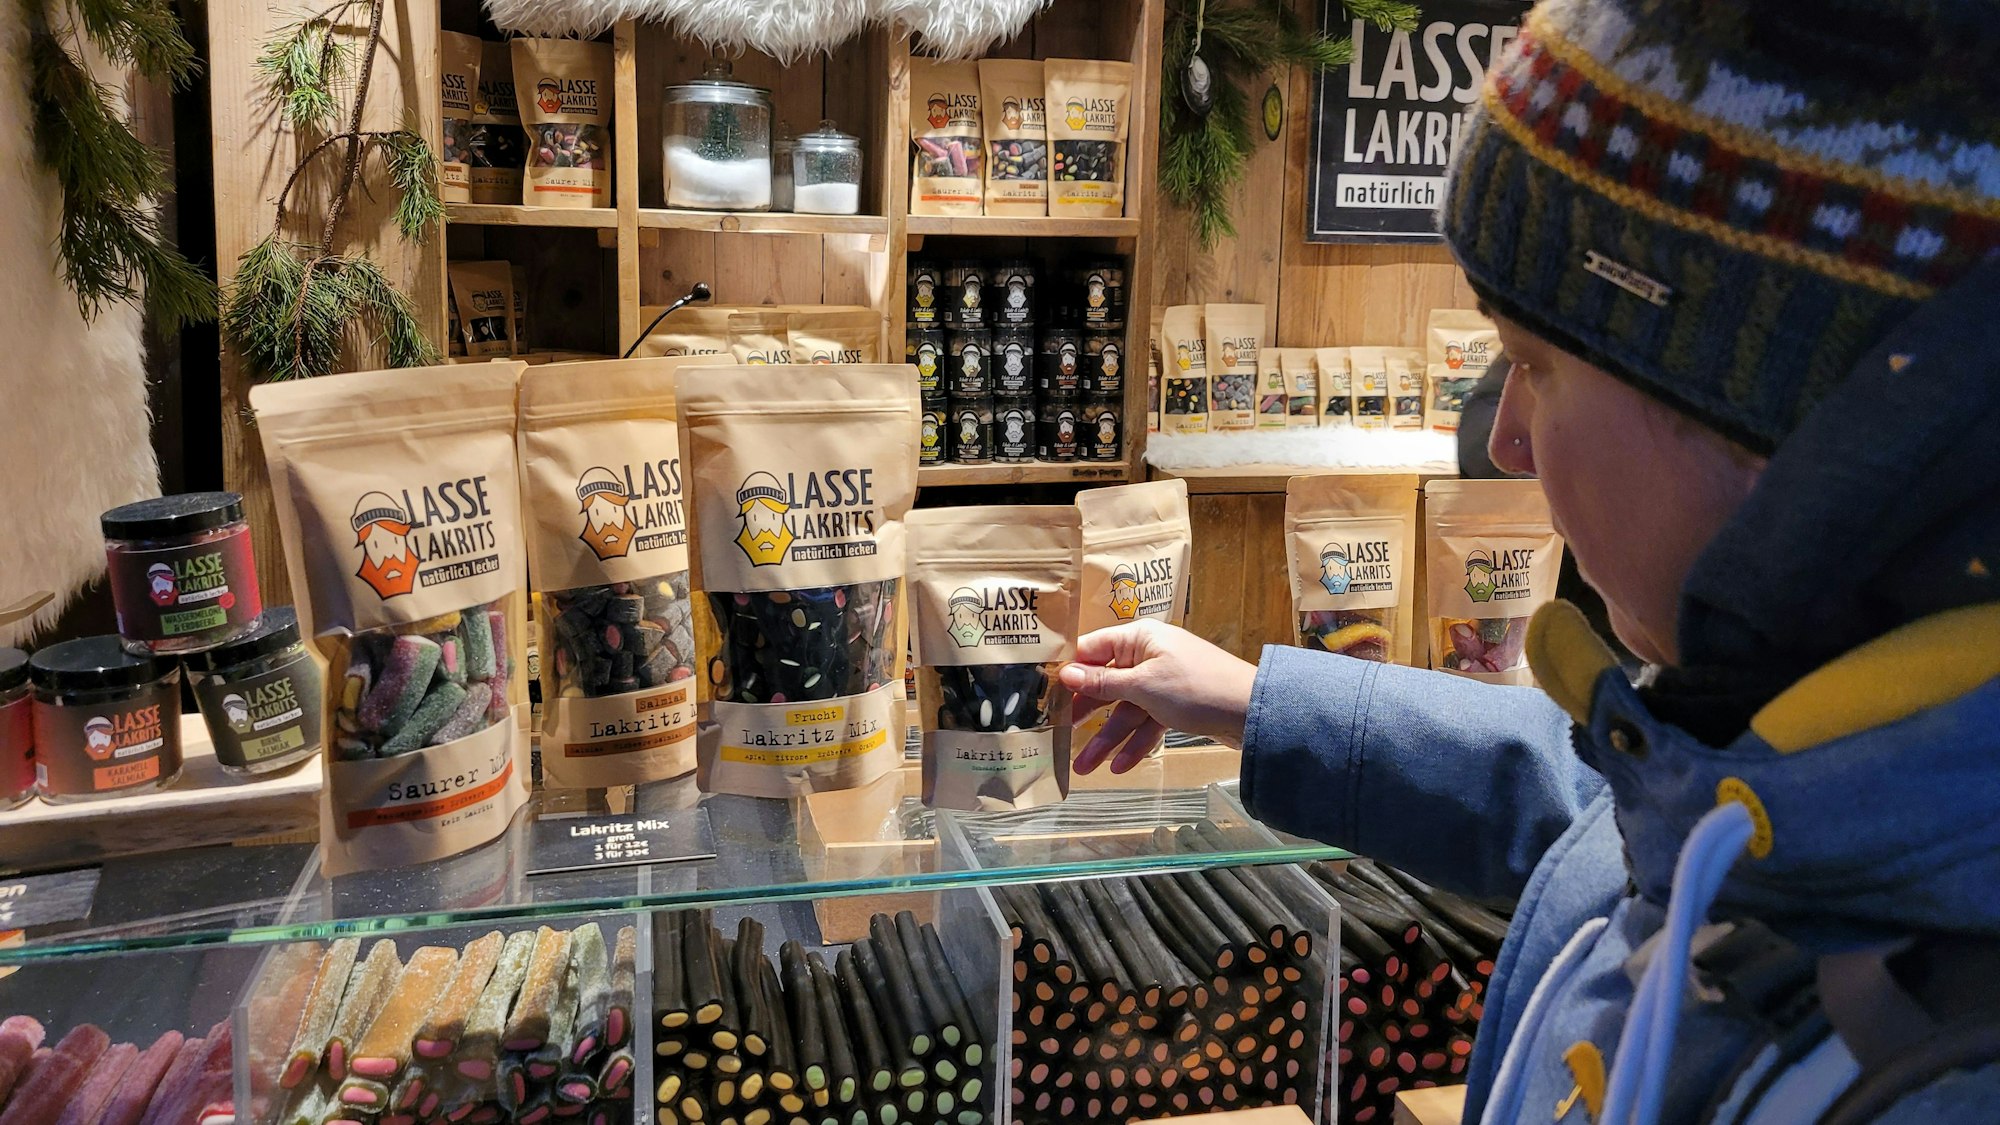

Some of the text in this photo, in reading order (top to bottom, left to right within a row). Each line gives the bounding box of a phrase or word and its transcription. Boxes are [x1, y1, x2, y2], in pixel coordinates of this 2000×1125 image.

[442, 73, 467, 90] ASSE
[486, 80, 514, 96] LASS
[560, 78, 597, 95] LASSE
[442, 88, 469, 102] AKRITS
[561, 94, 598, 107] LAKRITS
[948, 93, 977, 109] LASSE
[1020, 98, 1045, 112] LASS
[1085, 97, 1116, 113] LASSE
[1086, 113, 1116, 125] LAKRITS
[1343, 108, 1465, 166] LAKRI
[1344, 181, 1436, 205] natürlich
[1187, 339, 1206, 352] LASS
[1234, 337, 1256, 350] LASSE
[1462, 342, 1489, 355] LASSE
[766, 350, 791, 364] LASS
[624, 458, 682, 501] LASS
[787, 468, 874, 510] LASSE
[402, 476, 491, 529] LASSE
[791, 509, 874, 541] LAKRITS
[413, 520, 496, 564] LAKRITS
[638, 532, 688, 551] natürlich le
[794, 543, 876, 561] natürlich lecker
[1347, 541, 1390, 564] LASSE
[1492, 549, 1535, 571] LASSE
[174, 552, 224, 579] LASSE
[421, 557, 499, 587] natürlich lecker
[1134, 557, 1173, 586] LASSE
[1350, 564, 1392, 582] LAKRITS
[178, 571, 226, 594] LAKRITS
[1351, 582, 1376, 592] natürlich
[1494, 571, 1530, 589] LAKRITS
[983, 586, 1040, 612] LASSE
[1138, 582, 1173, 603] LAKRITS
[984, 613, 1039, 632] LAKRITS
[986, 634, 1039, 645] natürlich lecker
[245, 677, 295, 709] LASSE
[250, 695, 299, 721] LAKRITS
[794, 710, 837, 724] Frucht
[114, 704, 161, 734] LASSE
[590, 711, 682, 739] Lakritz
[114, 723, 162, 748] LAKRITS
[742, 718, 878, 748] Lakritz Mix
[956, 746, 1040, 761] Lakritz Mix
[389, 767, 479, 801] Saurer
[571, 819, 671, 838] Lakritz Mix
[594, 840, 649, 853] 1 für 12€
[606, 833, 636, 844] groß
[594, 848, 650, 861] 3 für 30€
